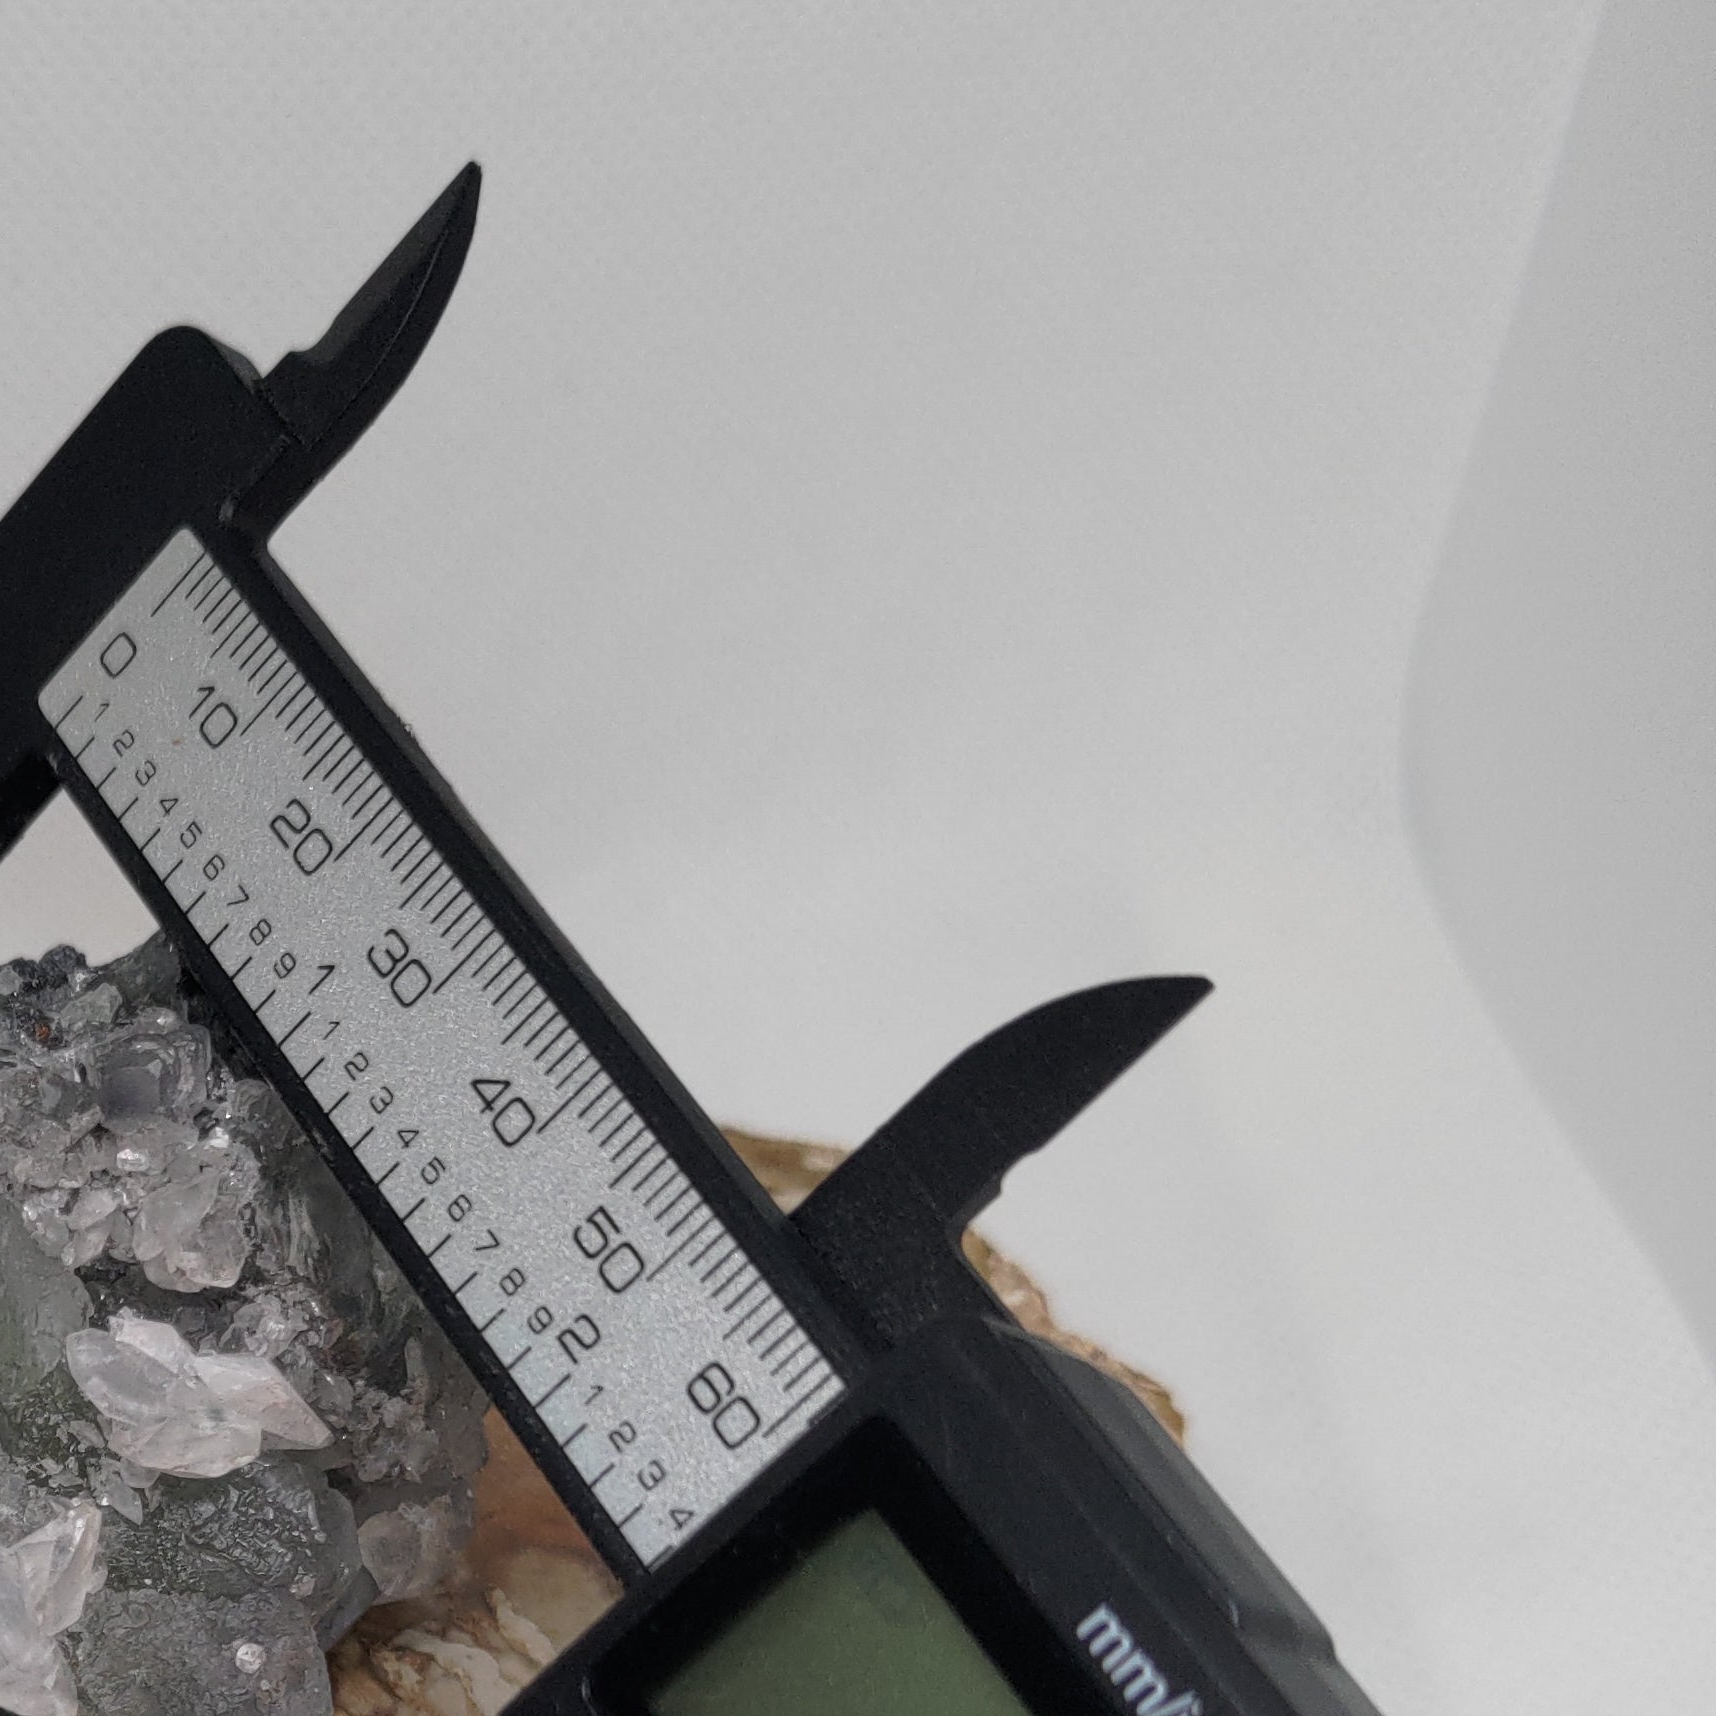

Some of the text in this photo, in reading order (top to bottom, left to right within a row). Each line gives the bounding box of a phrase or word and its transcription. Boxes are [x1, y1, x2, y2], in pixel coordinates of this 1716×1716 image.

[94, 701, 695, 1530] 1 2 3 4 5 6 7 8 9 1 1 2 3 4 5 6 7 8 9 2 1 2 3 4
[99, 632, 761, 1450] 0 10 20 30 40 50 60
